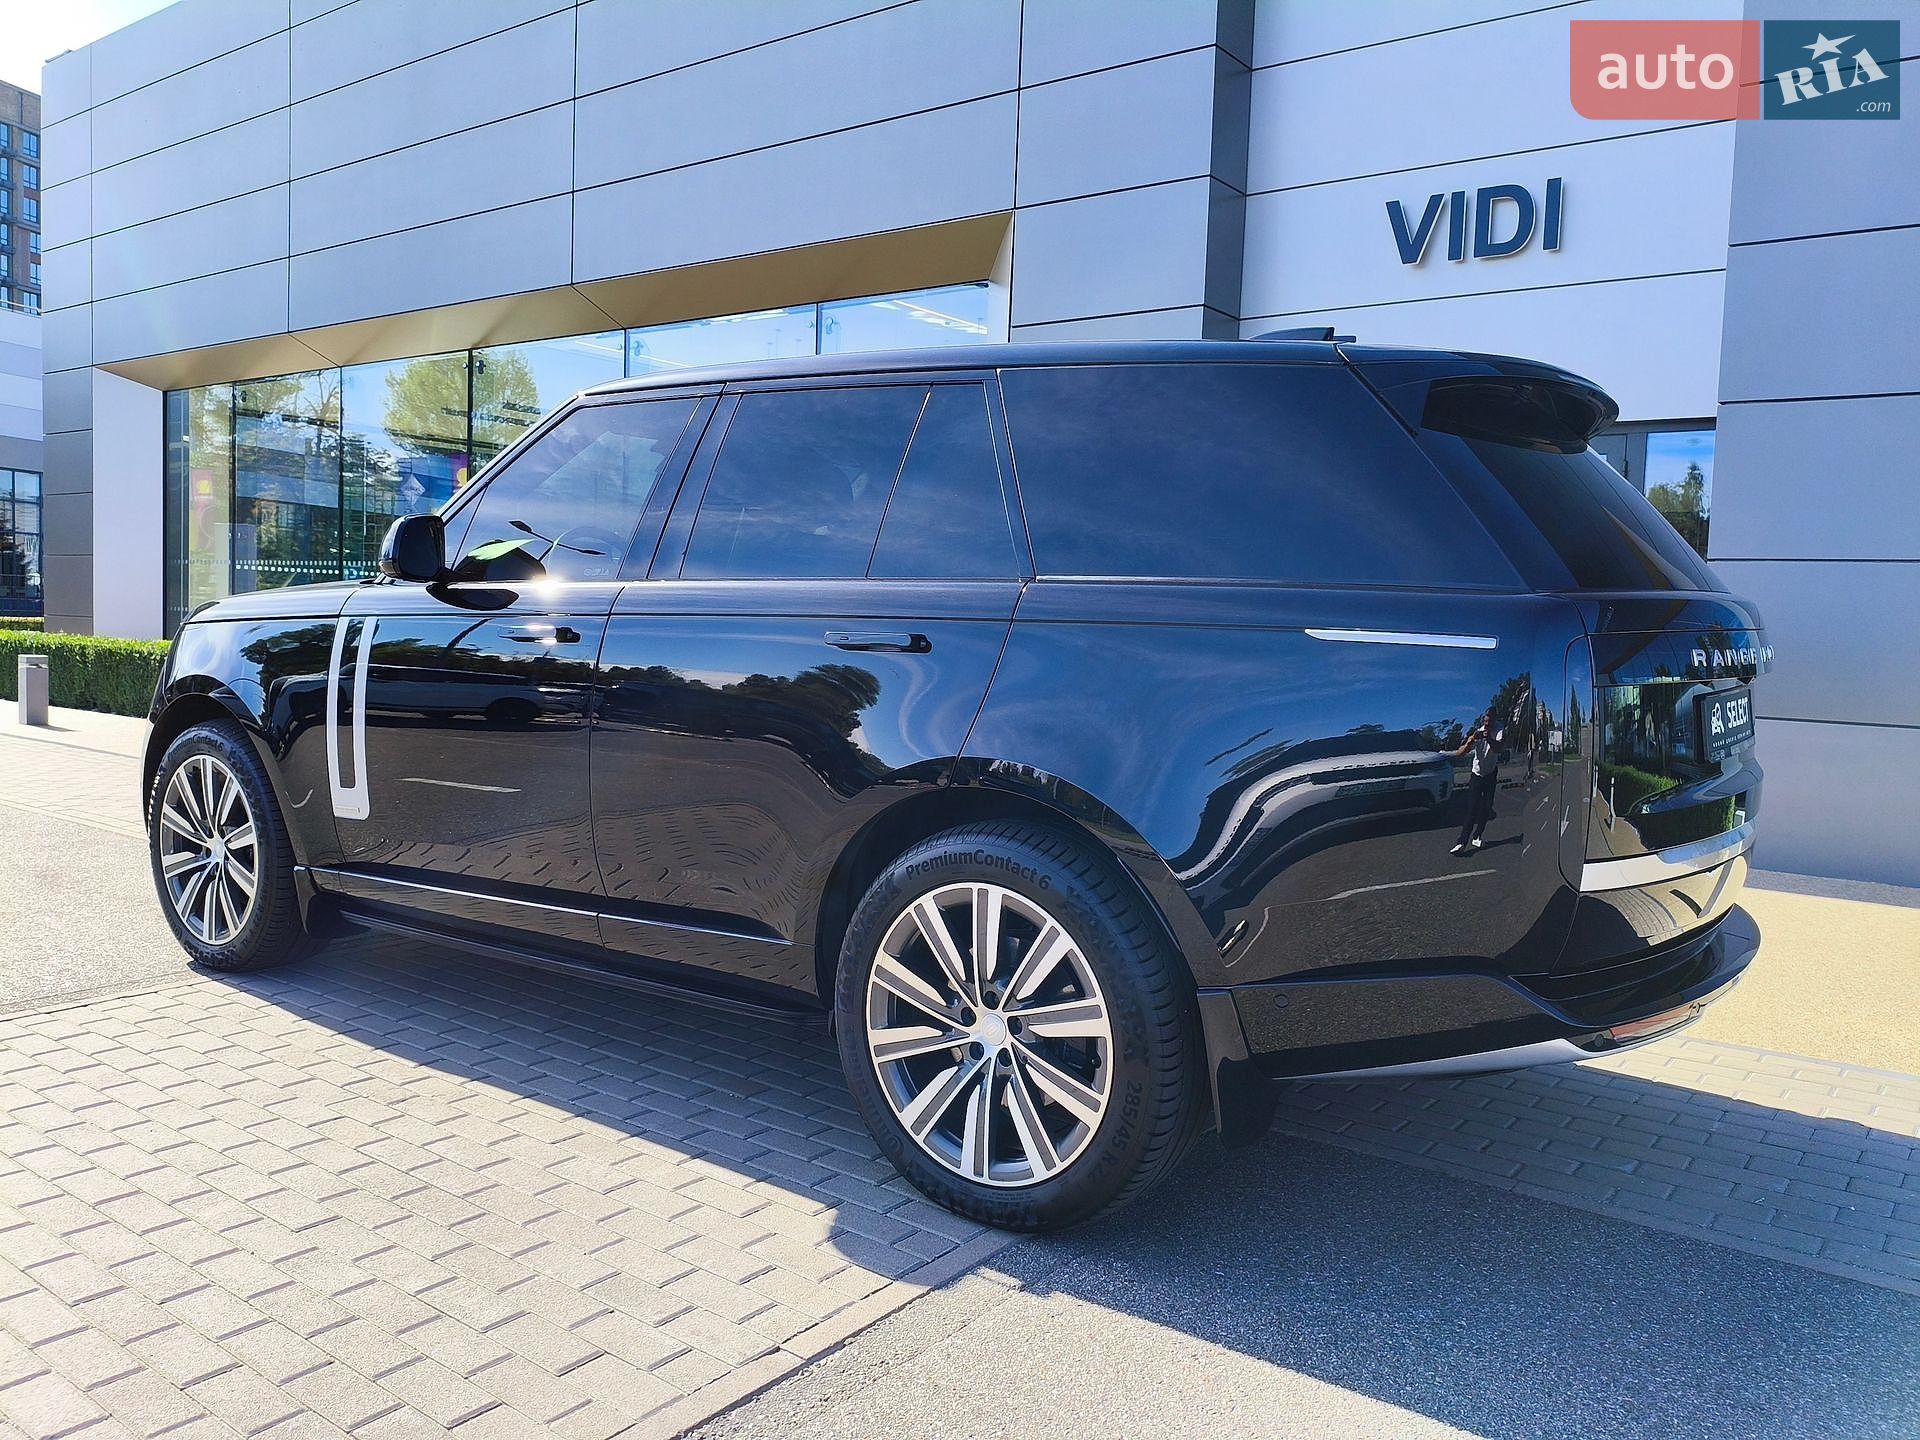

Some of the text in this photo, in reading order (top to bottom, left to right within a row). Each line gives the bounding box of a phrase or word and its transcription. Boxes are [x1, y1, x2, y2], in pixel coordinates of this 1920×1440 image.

[1385, 176, 1562, 265] VIDI
[1726, 696, 1749, 729] SELECT
[905, 849, 1052, 891] PremiumContact 6
